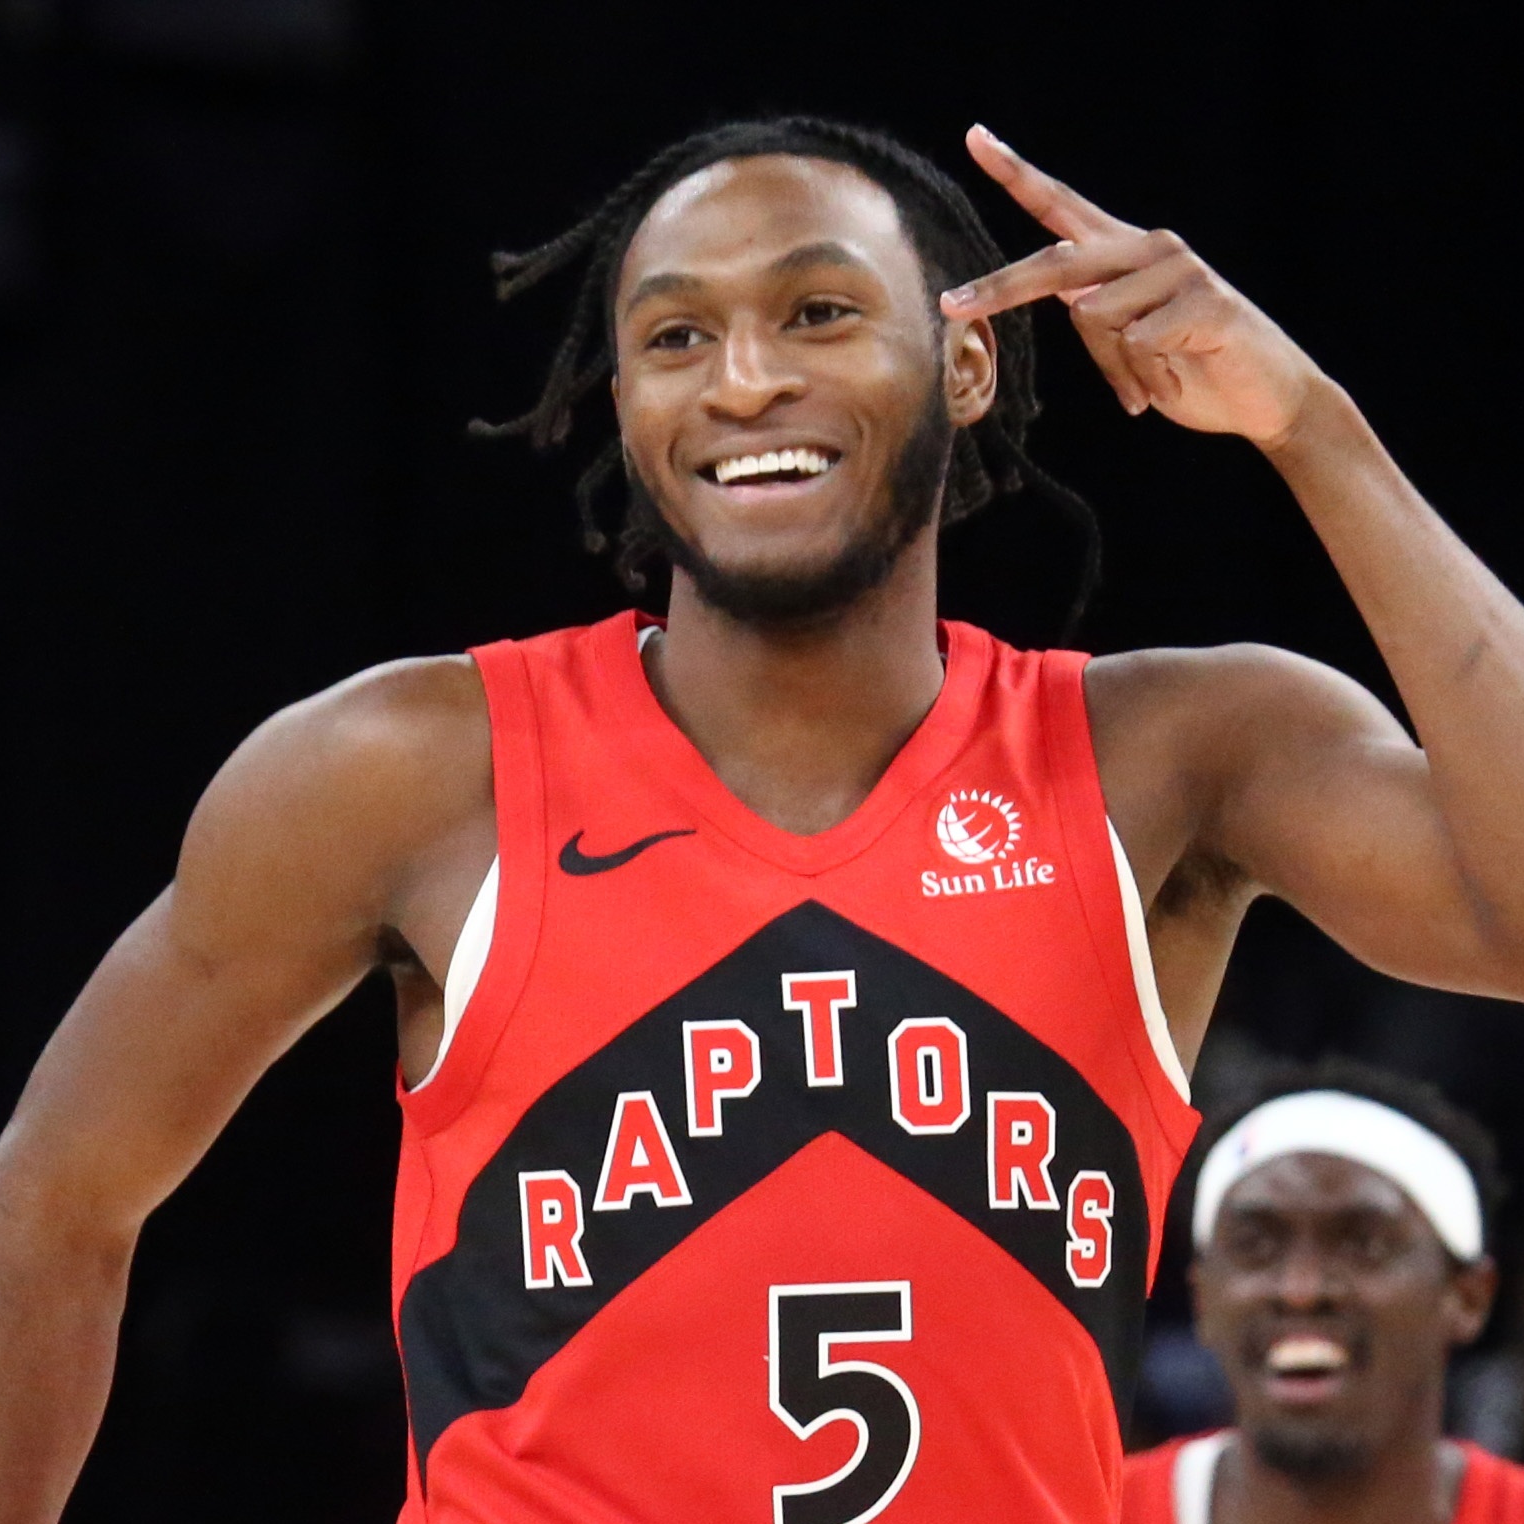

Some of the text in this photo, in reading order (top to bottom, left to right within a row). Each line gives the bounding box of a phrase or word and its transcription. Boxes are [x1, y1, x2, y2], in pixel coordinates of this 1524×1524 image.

[920, 857, 1055, 897] Sun Life
[519, 970, 1114, 1288] RAPTORS
